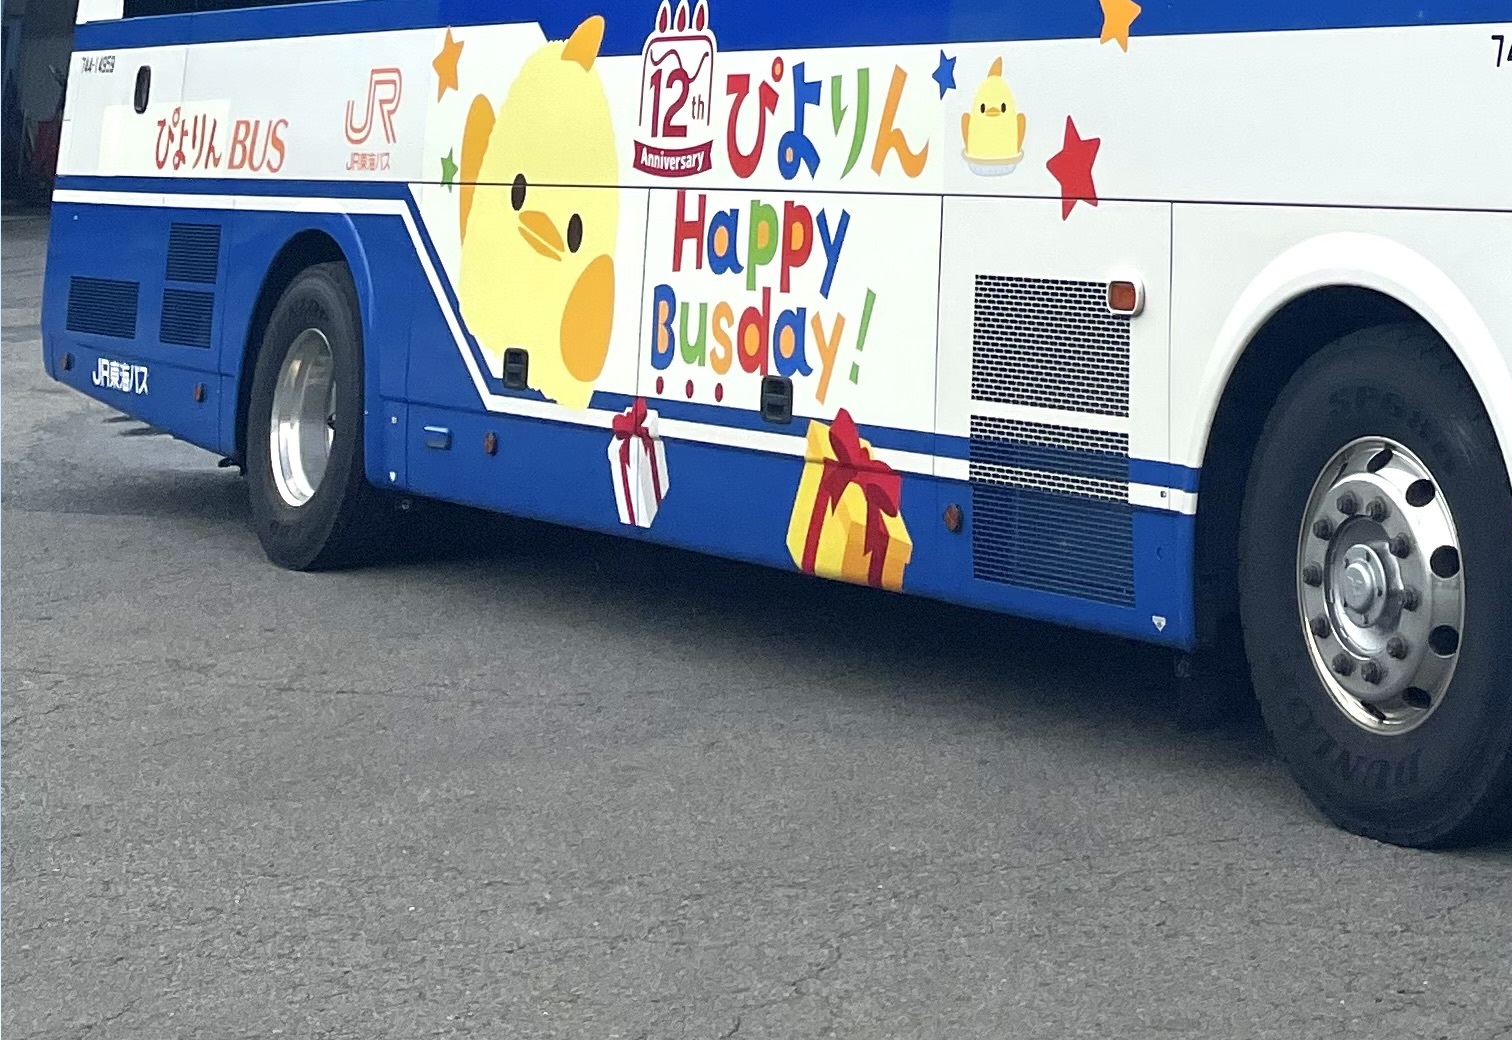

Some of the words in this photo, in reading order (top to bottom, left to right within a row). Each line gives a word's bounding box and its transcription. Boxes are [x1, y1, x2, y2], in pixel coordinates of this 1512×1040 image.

[345, 67, 402, 145] JR
[227, 118, 288, 173] BUS
[640, 146, 705, 172] Anniversary
[672, 189, 851, 300] Happy
[92, 357, 149, 395] JR東海バス
[650, 284, 877, 405] Busday!
